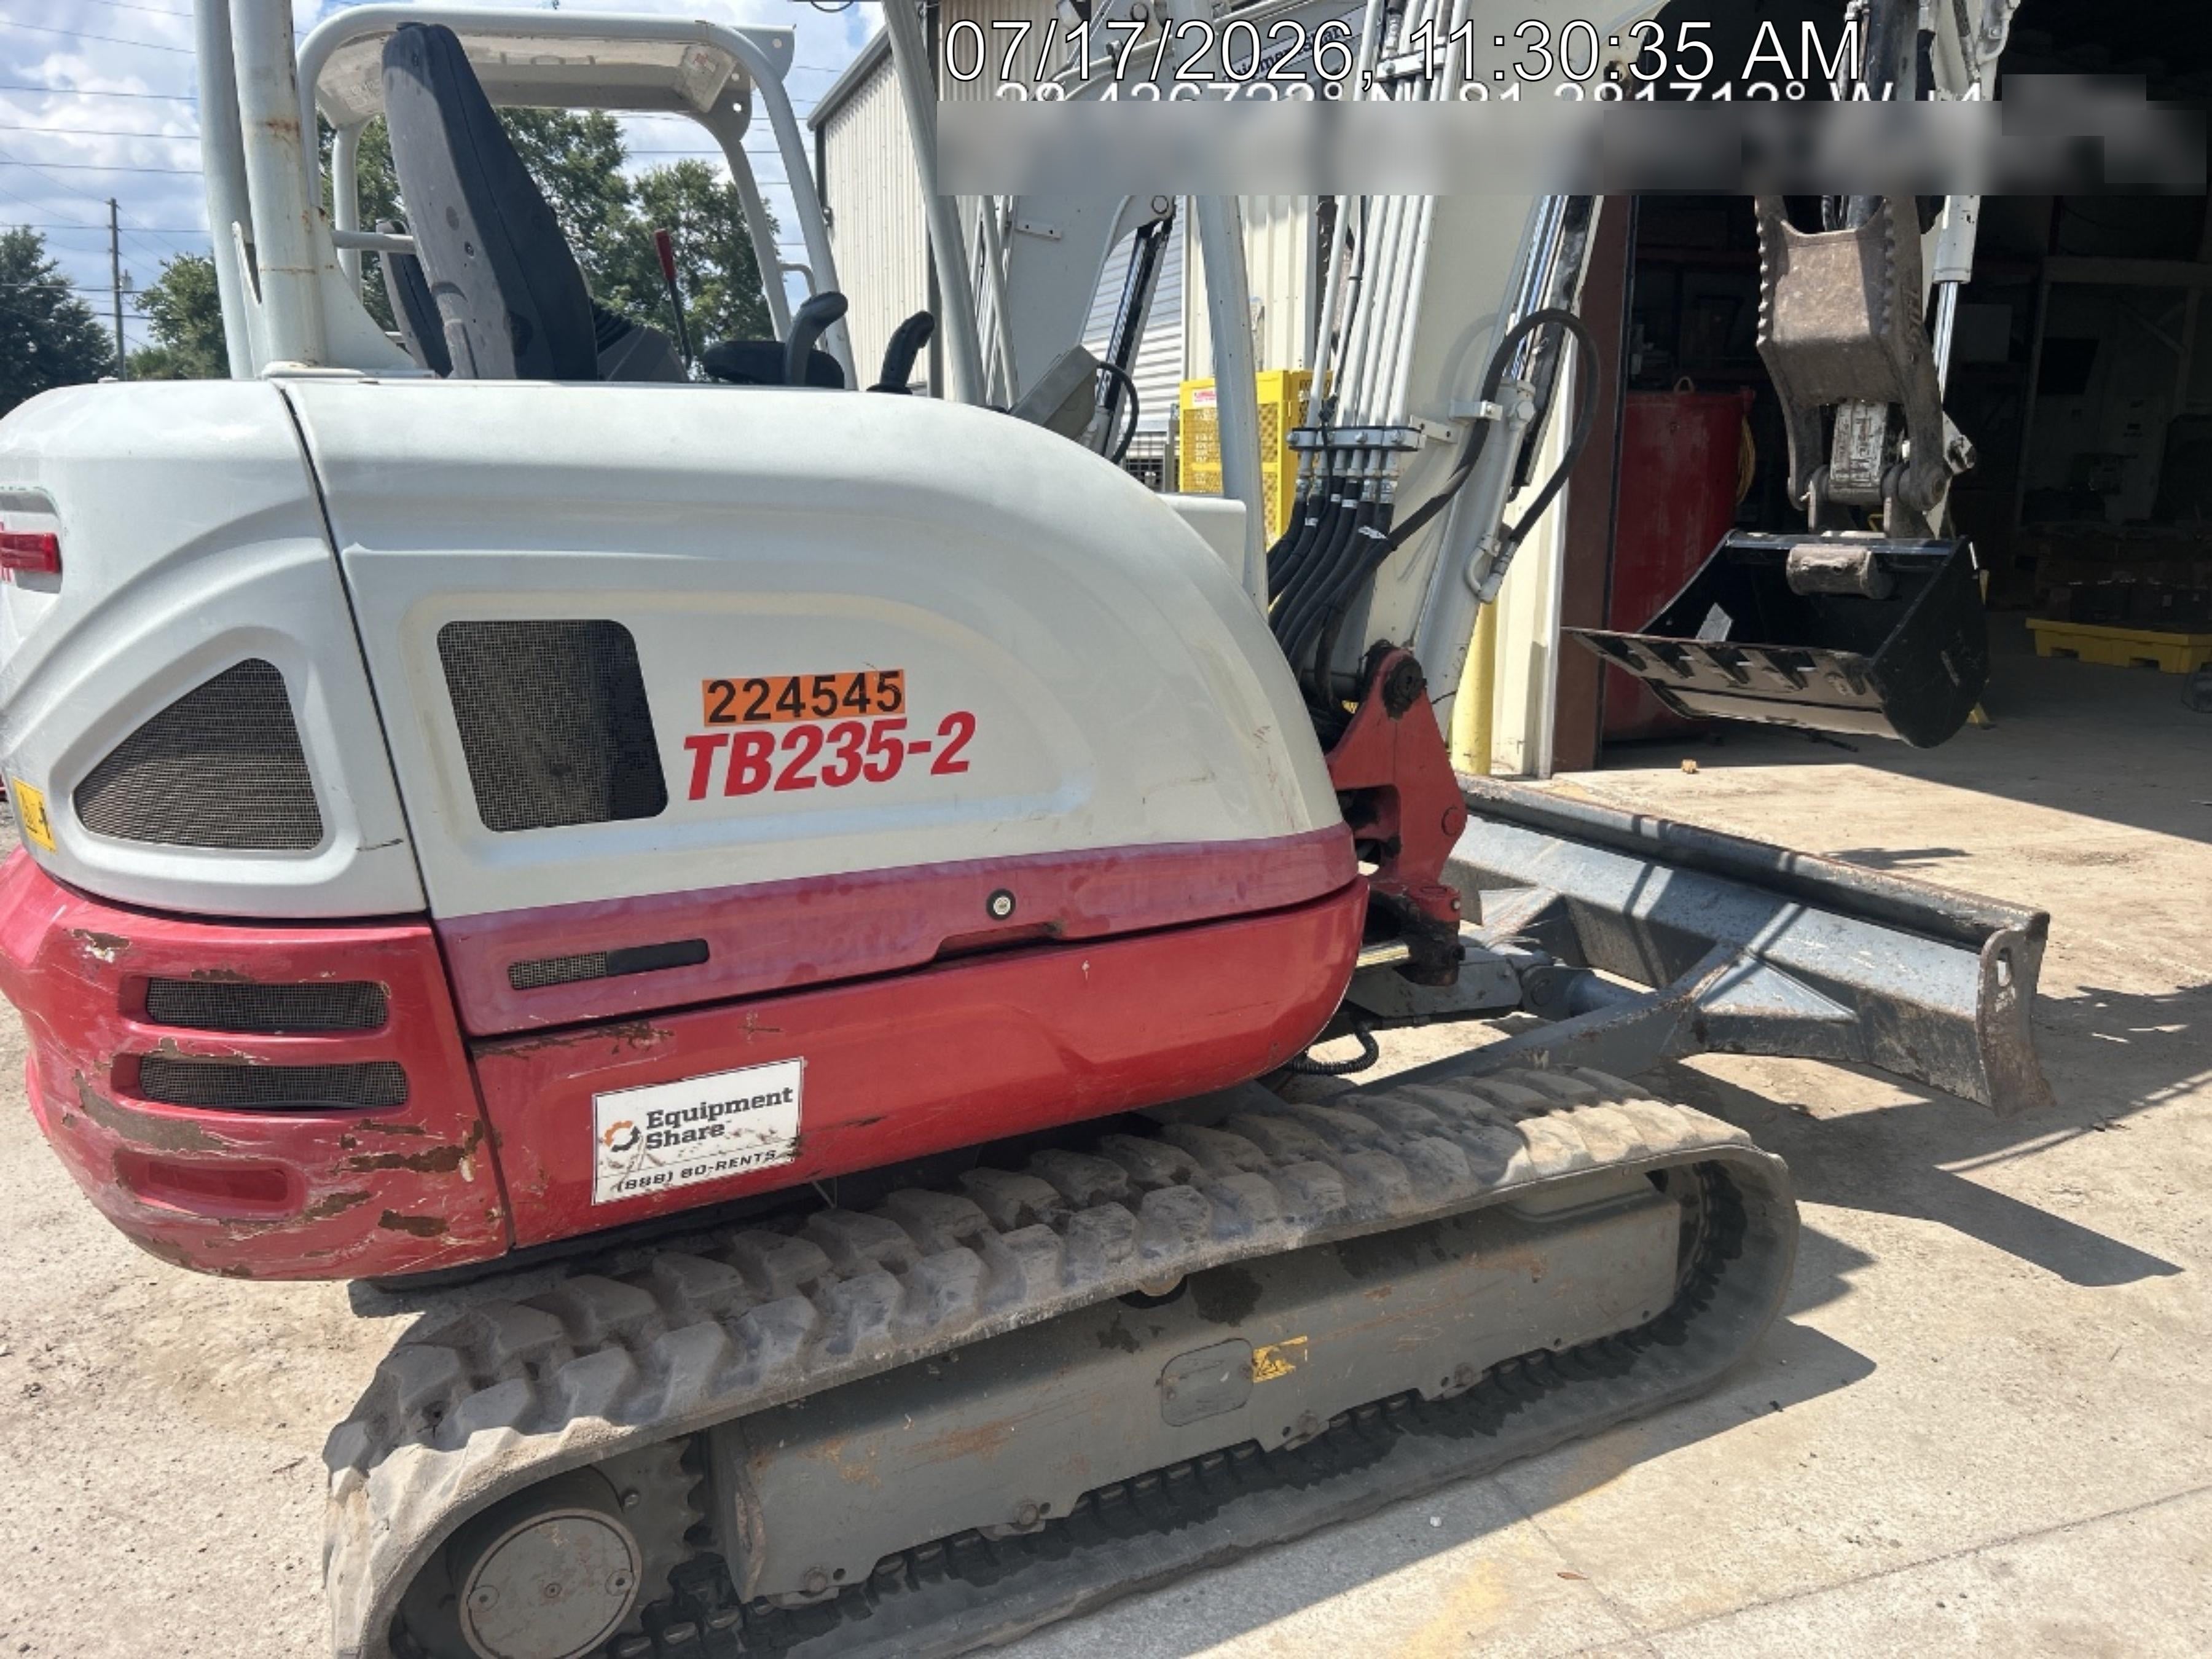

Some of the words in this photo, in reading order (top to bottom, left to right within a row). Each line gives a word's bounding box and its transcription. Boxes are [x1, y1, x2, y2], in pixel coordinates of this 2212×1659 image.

[707, 671, 903, 723] 224545
[683, 711, 977, 801] TB235-2
[646, 1086, 793, 1129] Equipment
[646, 1123, 726, 1150] Share
[617, 1171, 673, 1193] (888)
[681, 1150, 777, 1179] 80-RENTS
